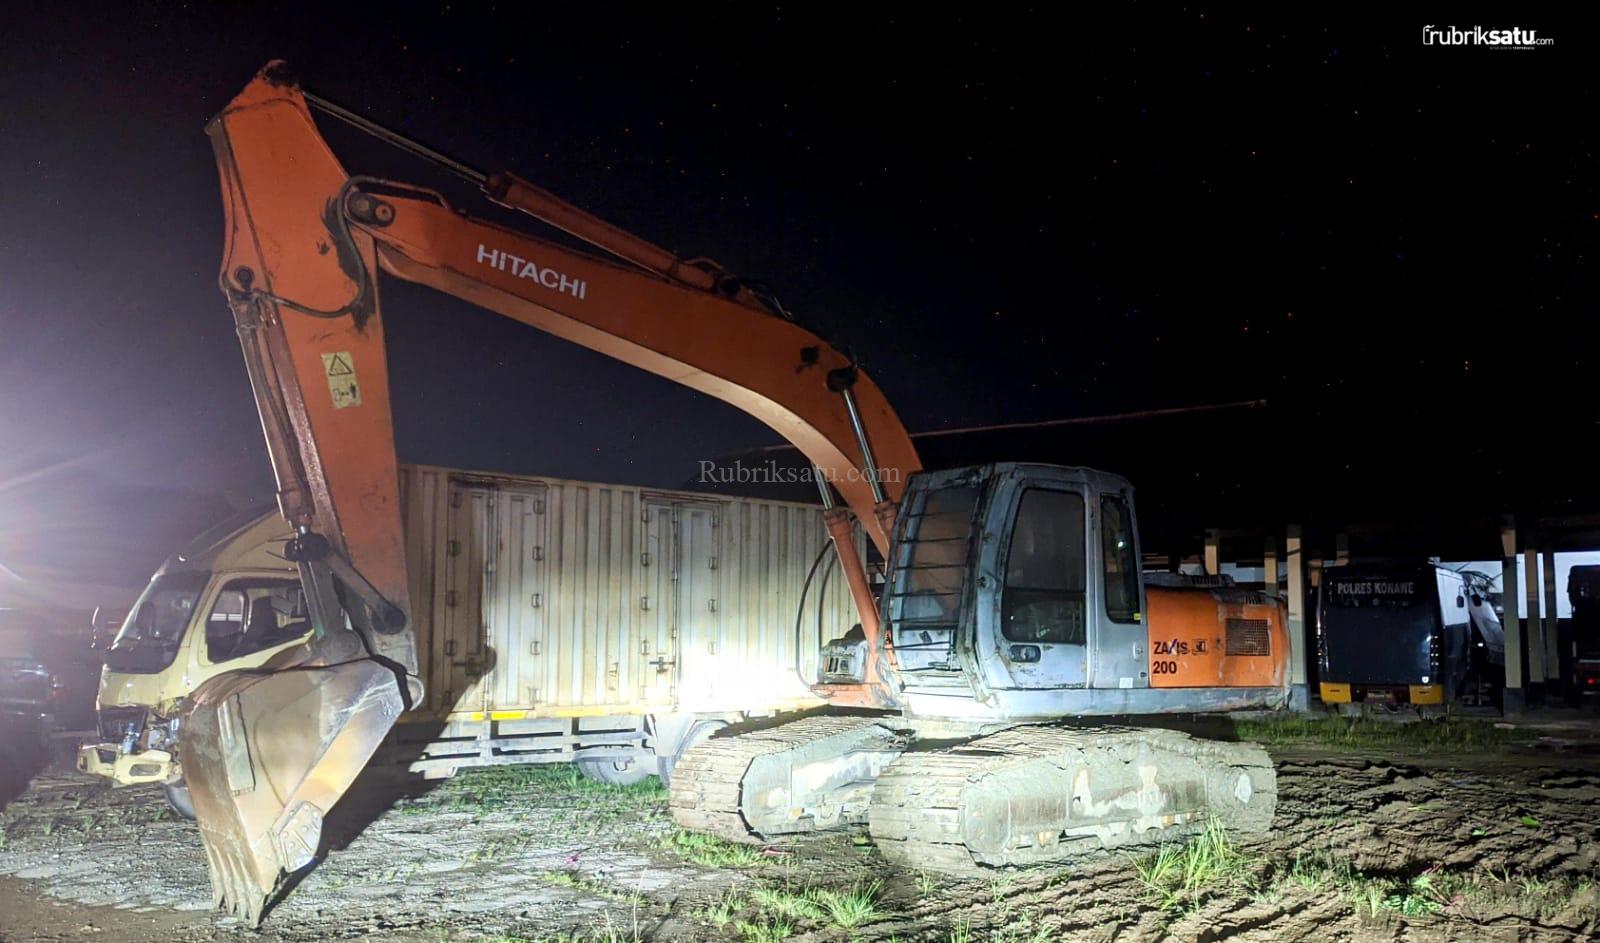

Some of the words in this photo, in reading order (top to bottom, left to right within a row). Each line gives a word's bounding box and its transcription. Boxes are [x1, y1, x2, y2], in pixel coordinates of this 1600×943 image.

[477, 244, 587, 300] HITACHI
[1337, 582, 1372, 595] POLRES
[1374, 582, 1415, 595] KONAWE
[1153, 660, 1178, 674] 200
